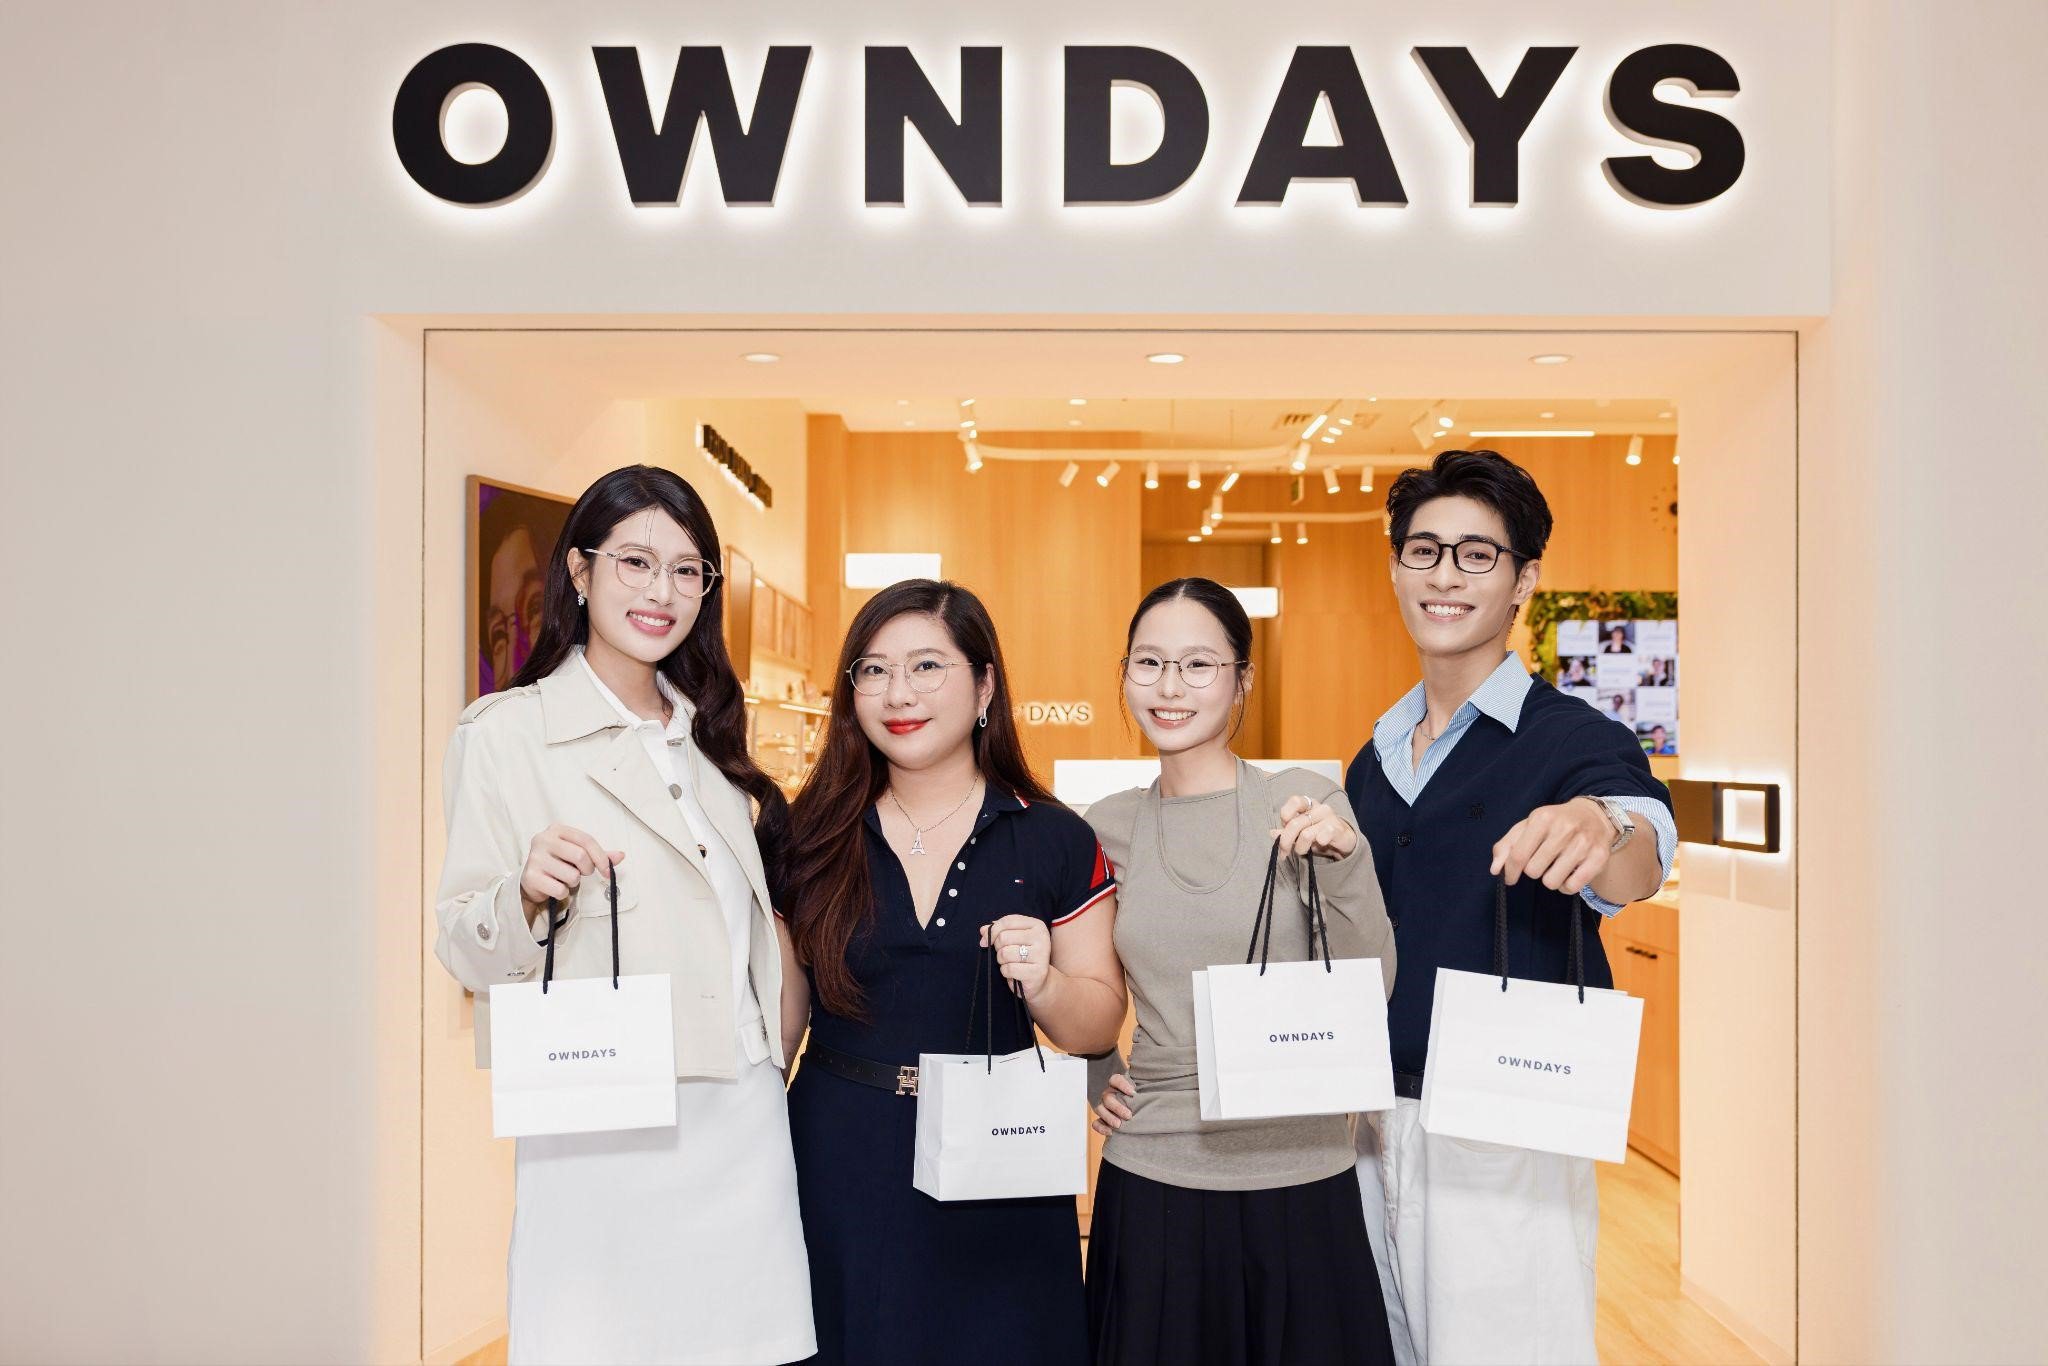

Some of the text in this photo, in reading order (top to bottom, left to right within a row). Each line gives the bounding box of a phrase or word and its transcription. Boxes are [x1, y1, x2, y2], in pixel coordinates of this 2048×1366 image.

[392, 42, 1746, 206] OWNDAYS
[1020, 704, 1090, 721] DAYS
[1269, 1031, 1335, 1043] OWNDAYS
[548, 1048, 617, 1062] OWNDAYS
[1497, 1055, 1572, 1075] OWNDAYS
[991, 1125, 1046, 1136] OWNDAYS
